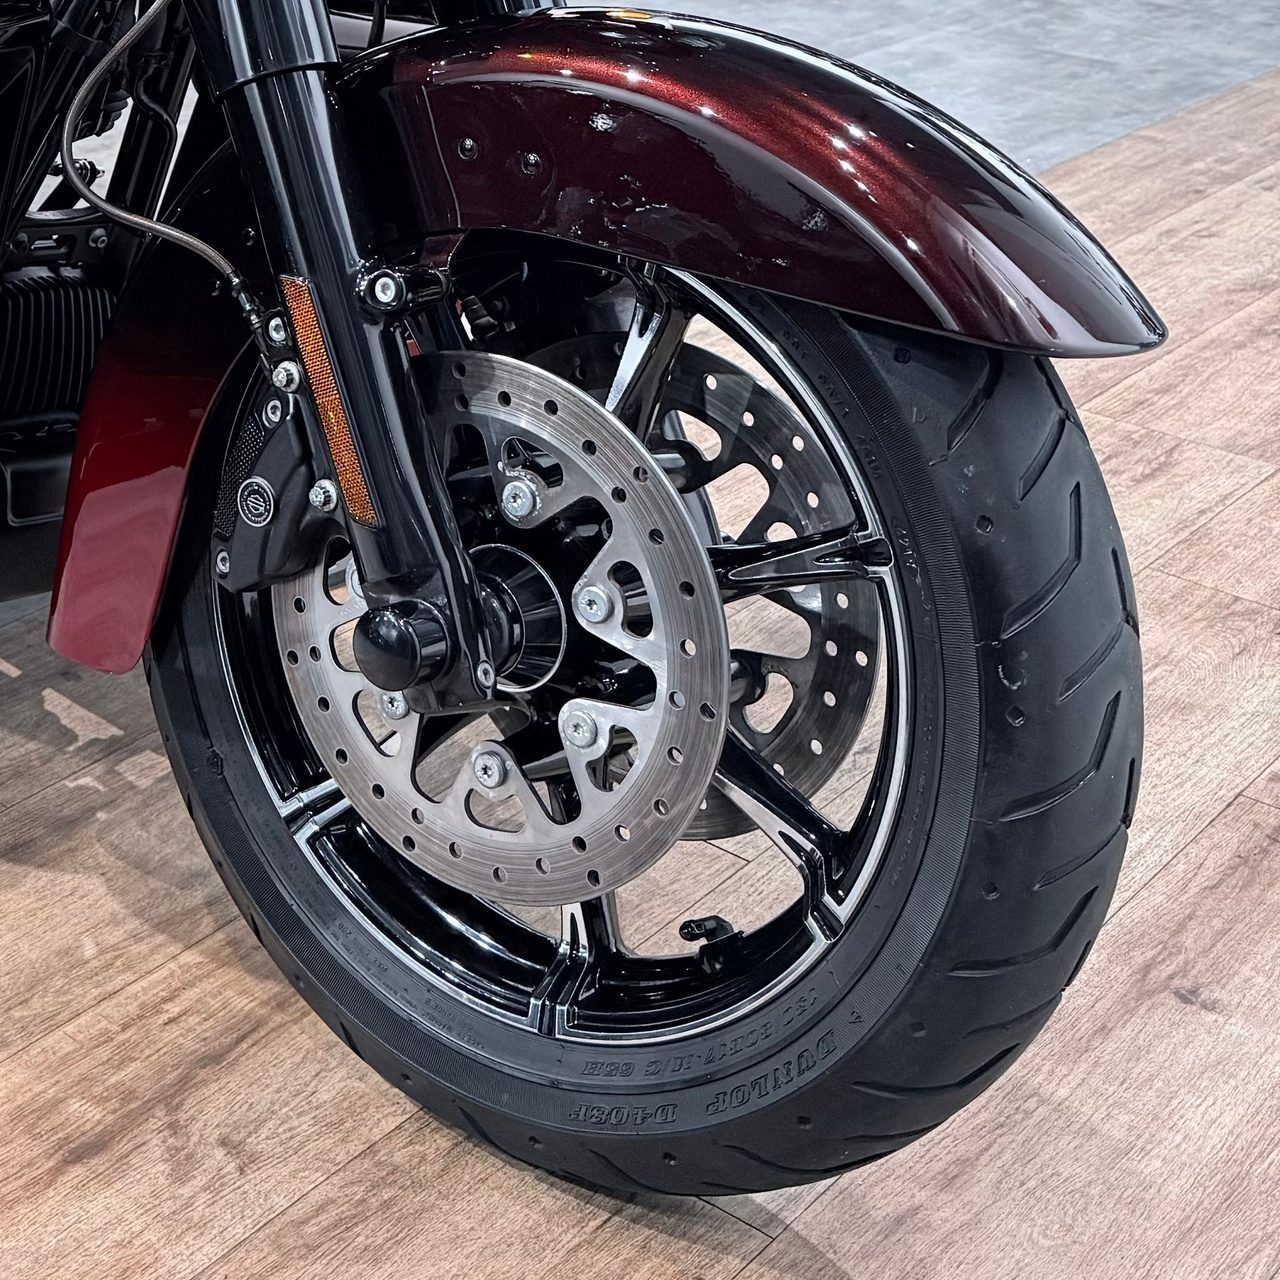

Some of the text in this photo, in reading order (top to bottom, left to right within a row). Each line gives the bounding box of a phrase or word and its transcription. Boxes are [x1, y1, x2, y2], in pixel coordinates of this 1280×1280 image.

[568, 1027, 839, 1126] DUNLOP D408F
[580, 1060, 636, 1078] 65H
